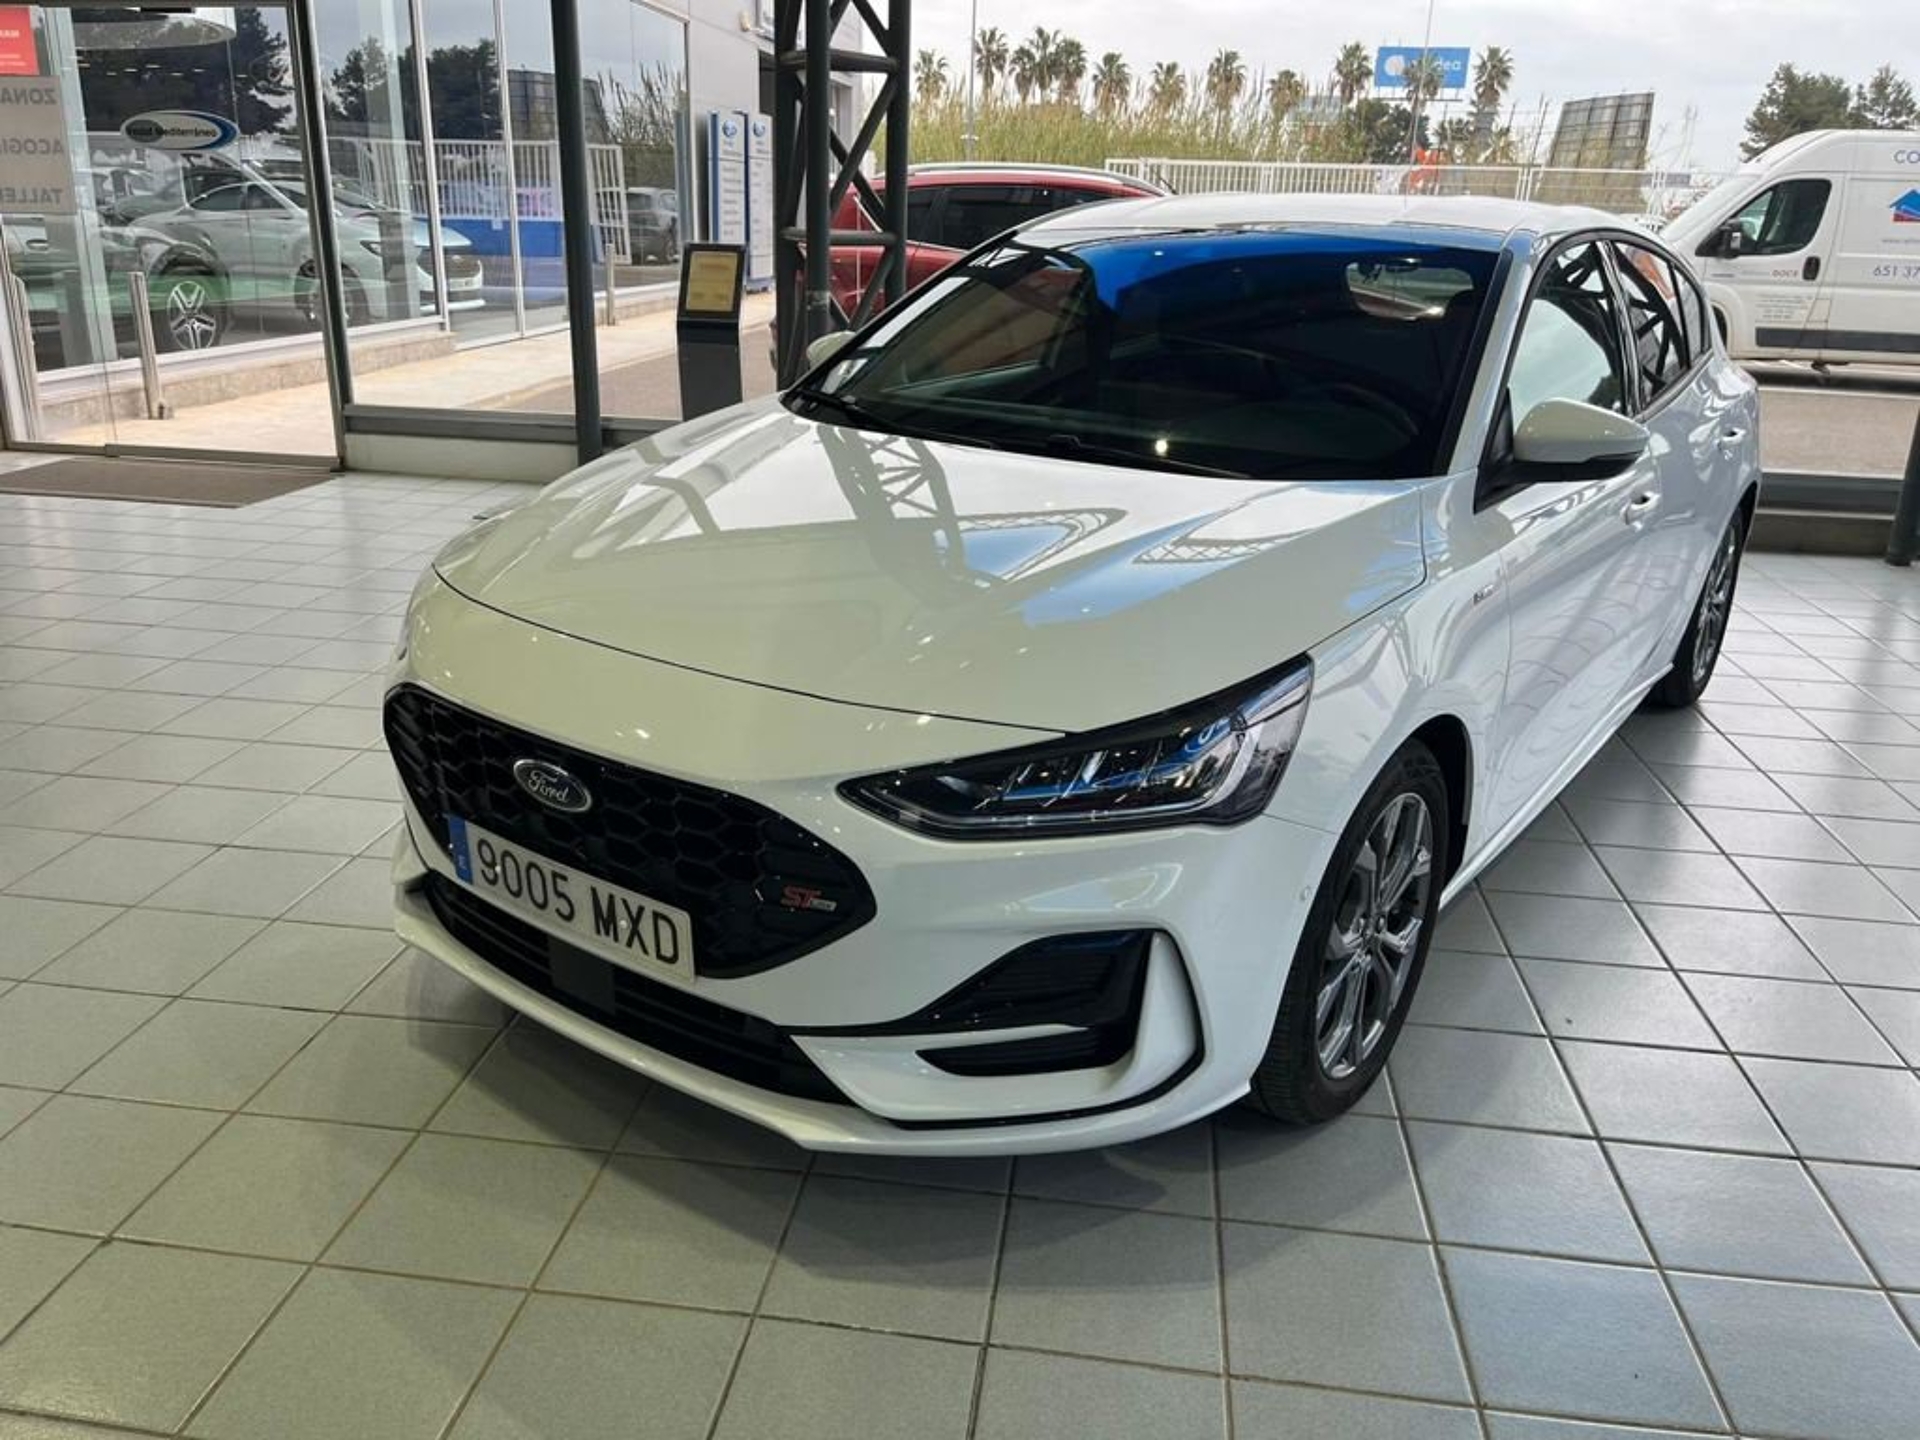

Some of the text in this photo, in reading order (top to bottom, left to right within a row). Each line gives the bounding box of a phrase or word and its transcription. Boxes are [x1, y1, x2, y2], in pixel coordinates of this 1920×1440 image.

[528, 770, 570, 803] Ford
[477, 838, 575, 922] 9005
[590, 884, 679, 965] MXD
